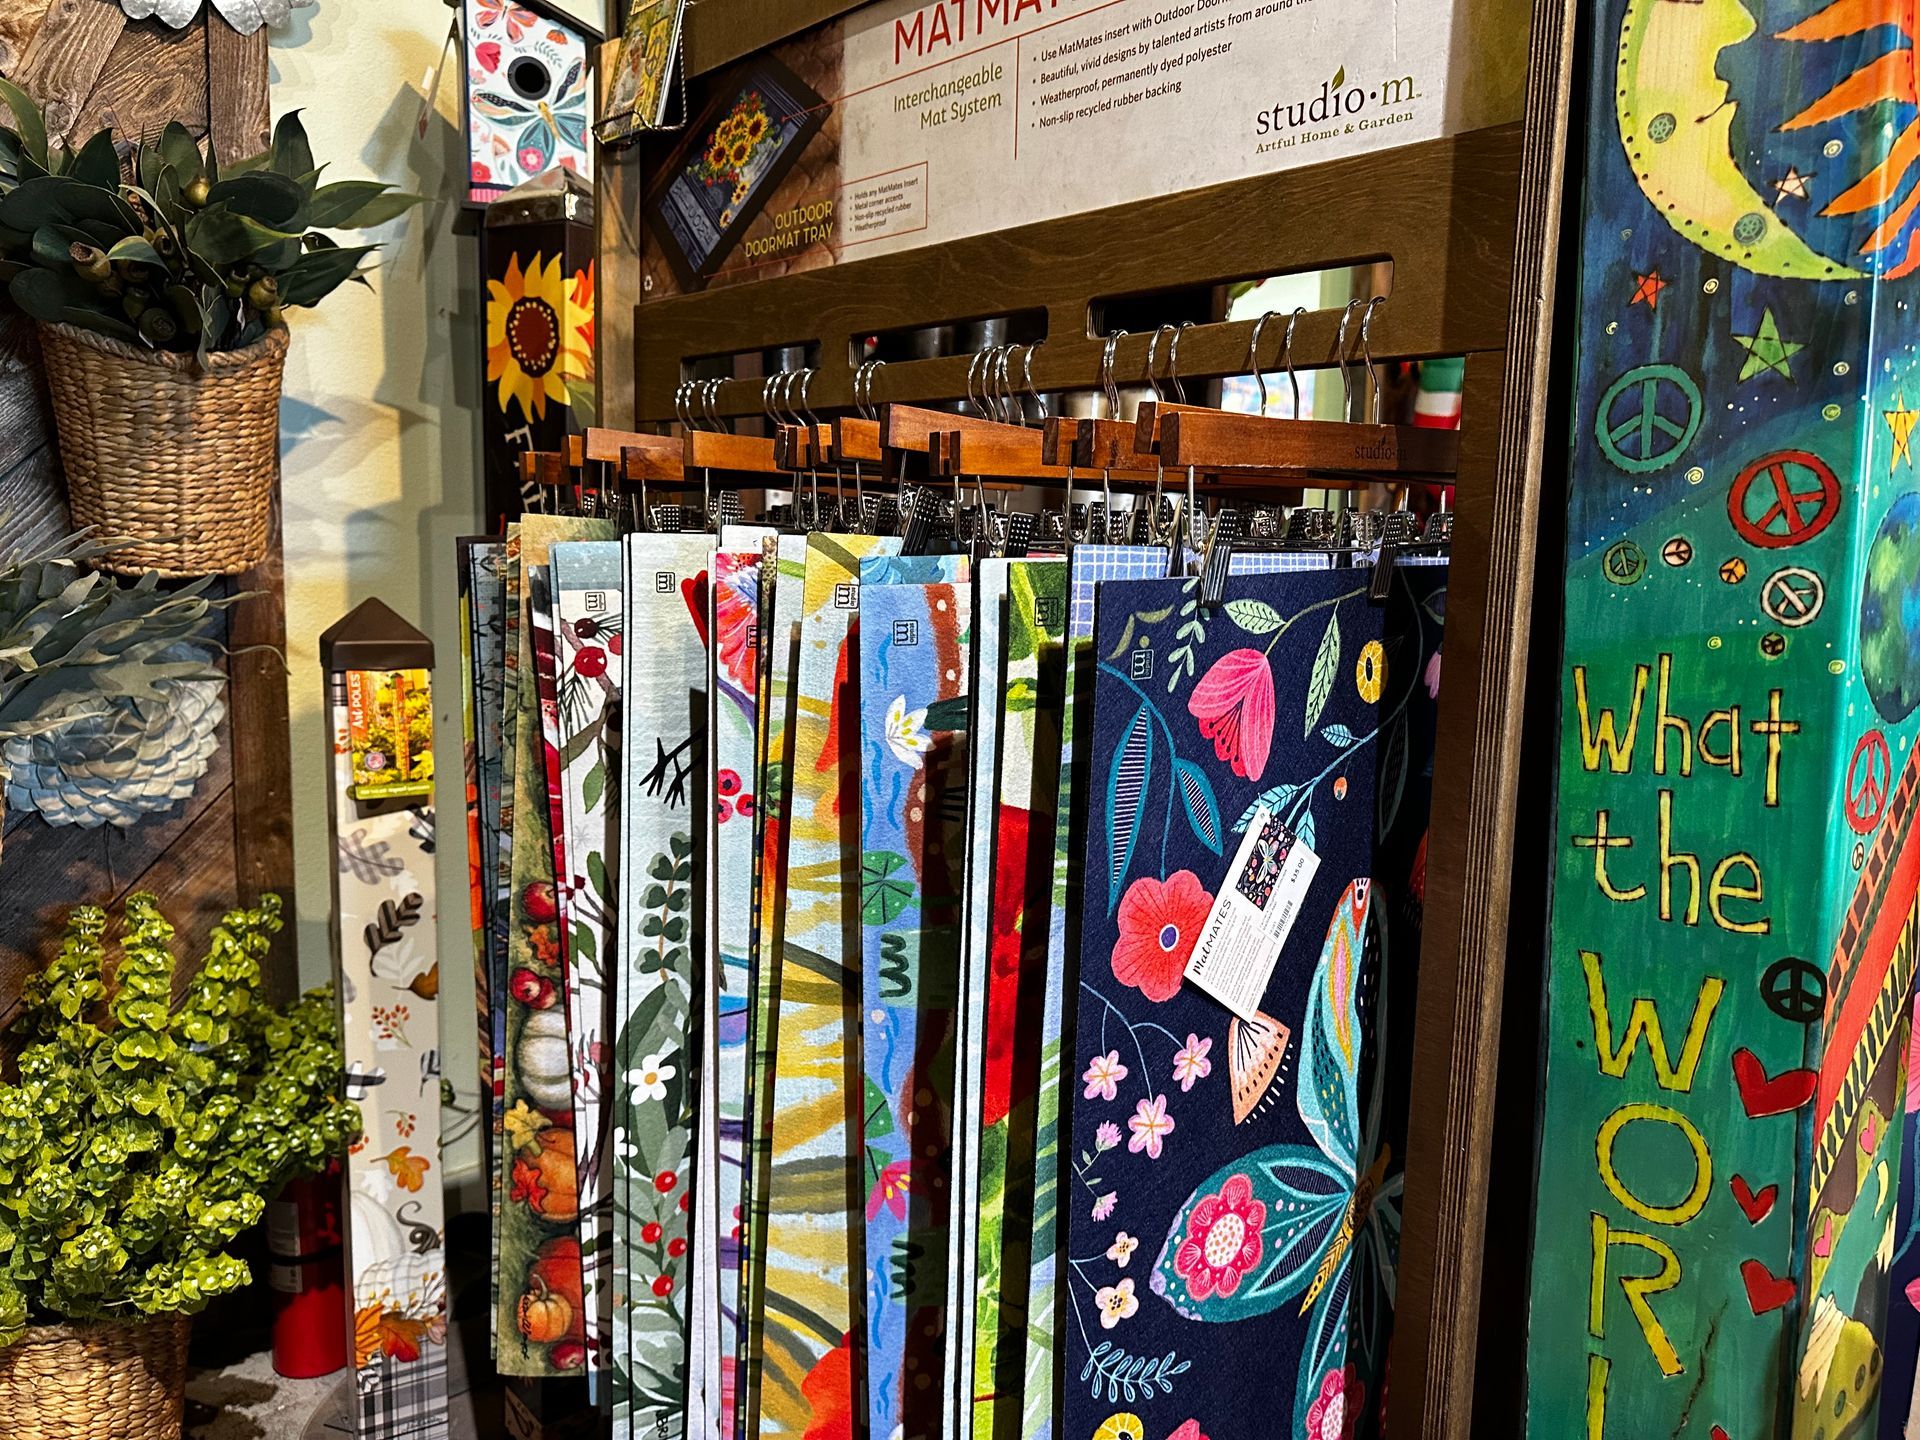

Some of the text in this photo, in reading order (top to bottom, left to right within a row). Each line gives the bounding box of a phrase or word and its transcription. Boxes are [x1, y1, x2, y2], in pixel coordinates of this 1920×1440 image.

[1040, 0, 1292, 84] Beautiful, vivid designs by talented artists from around
[1041, 49, 1057, 62] Use
[1058, 34, 1103, 56] MatMates
[1104, 25, 1130, 42] insert
[1132, 16, 1152, 32] with
[1154, 5, 1195, 25] Outdoor
[893, 62, 1003, 113] Interchangeable
[1040, 41, 1232, 106] Weatherproof, permanently dyed polyester
[920, 92, 1002, 130] Mat System
[1039, 80, 1182, 129] Non-slip recycled rubber backing
[1255, 111, 1414, 154] Artful Home & Garden
[855, 194, 903, 211] Metal corner accents
[869, 190, 877, 198] any
[875, 206, 895, 216] recycled
[896, 203, 912, 212] rubber
[774, 200, 833, 230] OUTDOOR
[855, 218, 887, 232] Weatherproof
[745, 221, 834, 257] DOORMAT TRAY
[658, 574, 668, 590] m
[837, 587, 850, 606] m
[587, 594, 598, 609] m
[896, 623, 909, 643] m
[1134, 653, 1145, 677] m
[350, 673, 364, 729] Art POLES
[1571, 652, 1801, 808] What
[1571, 788, 1771, 935] the
